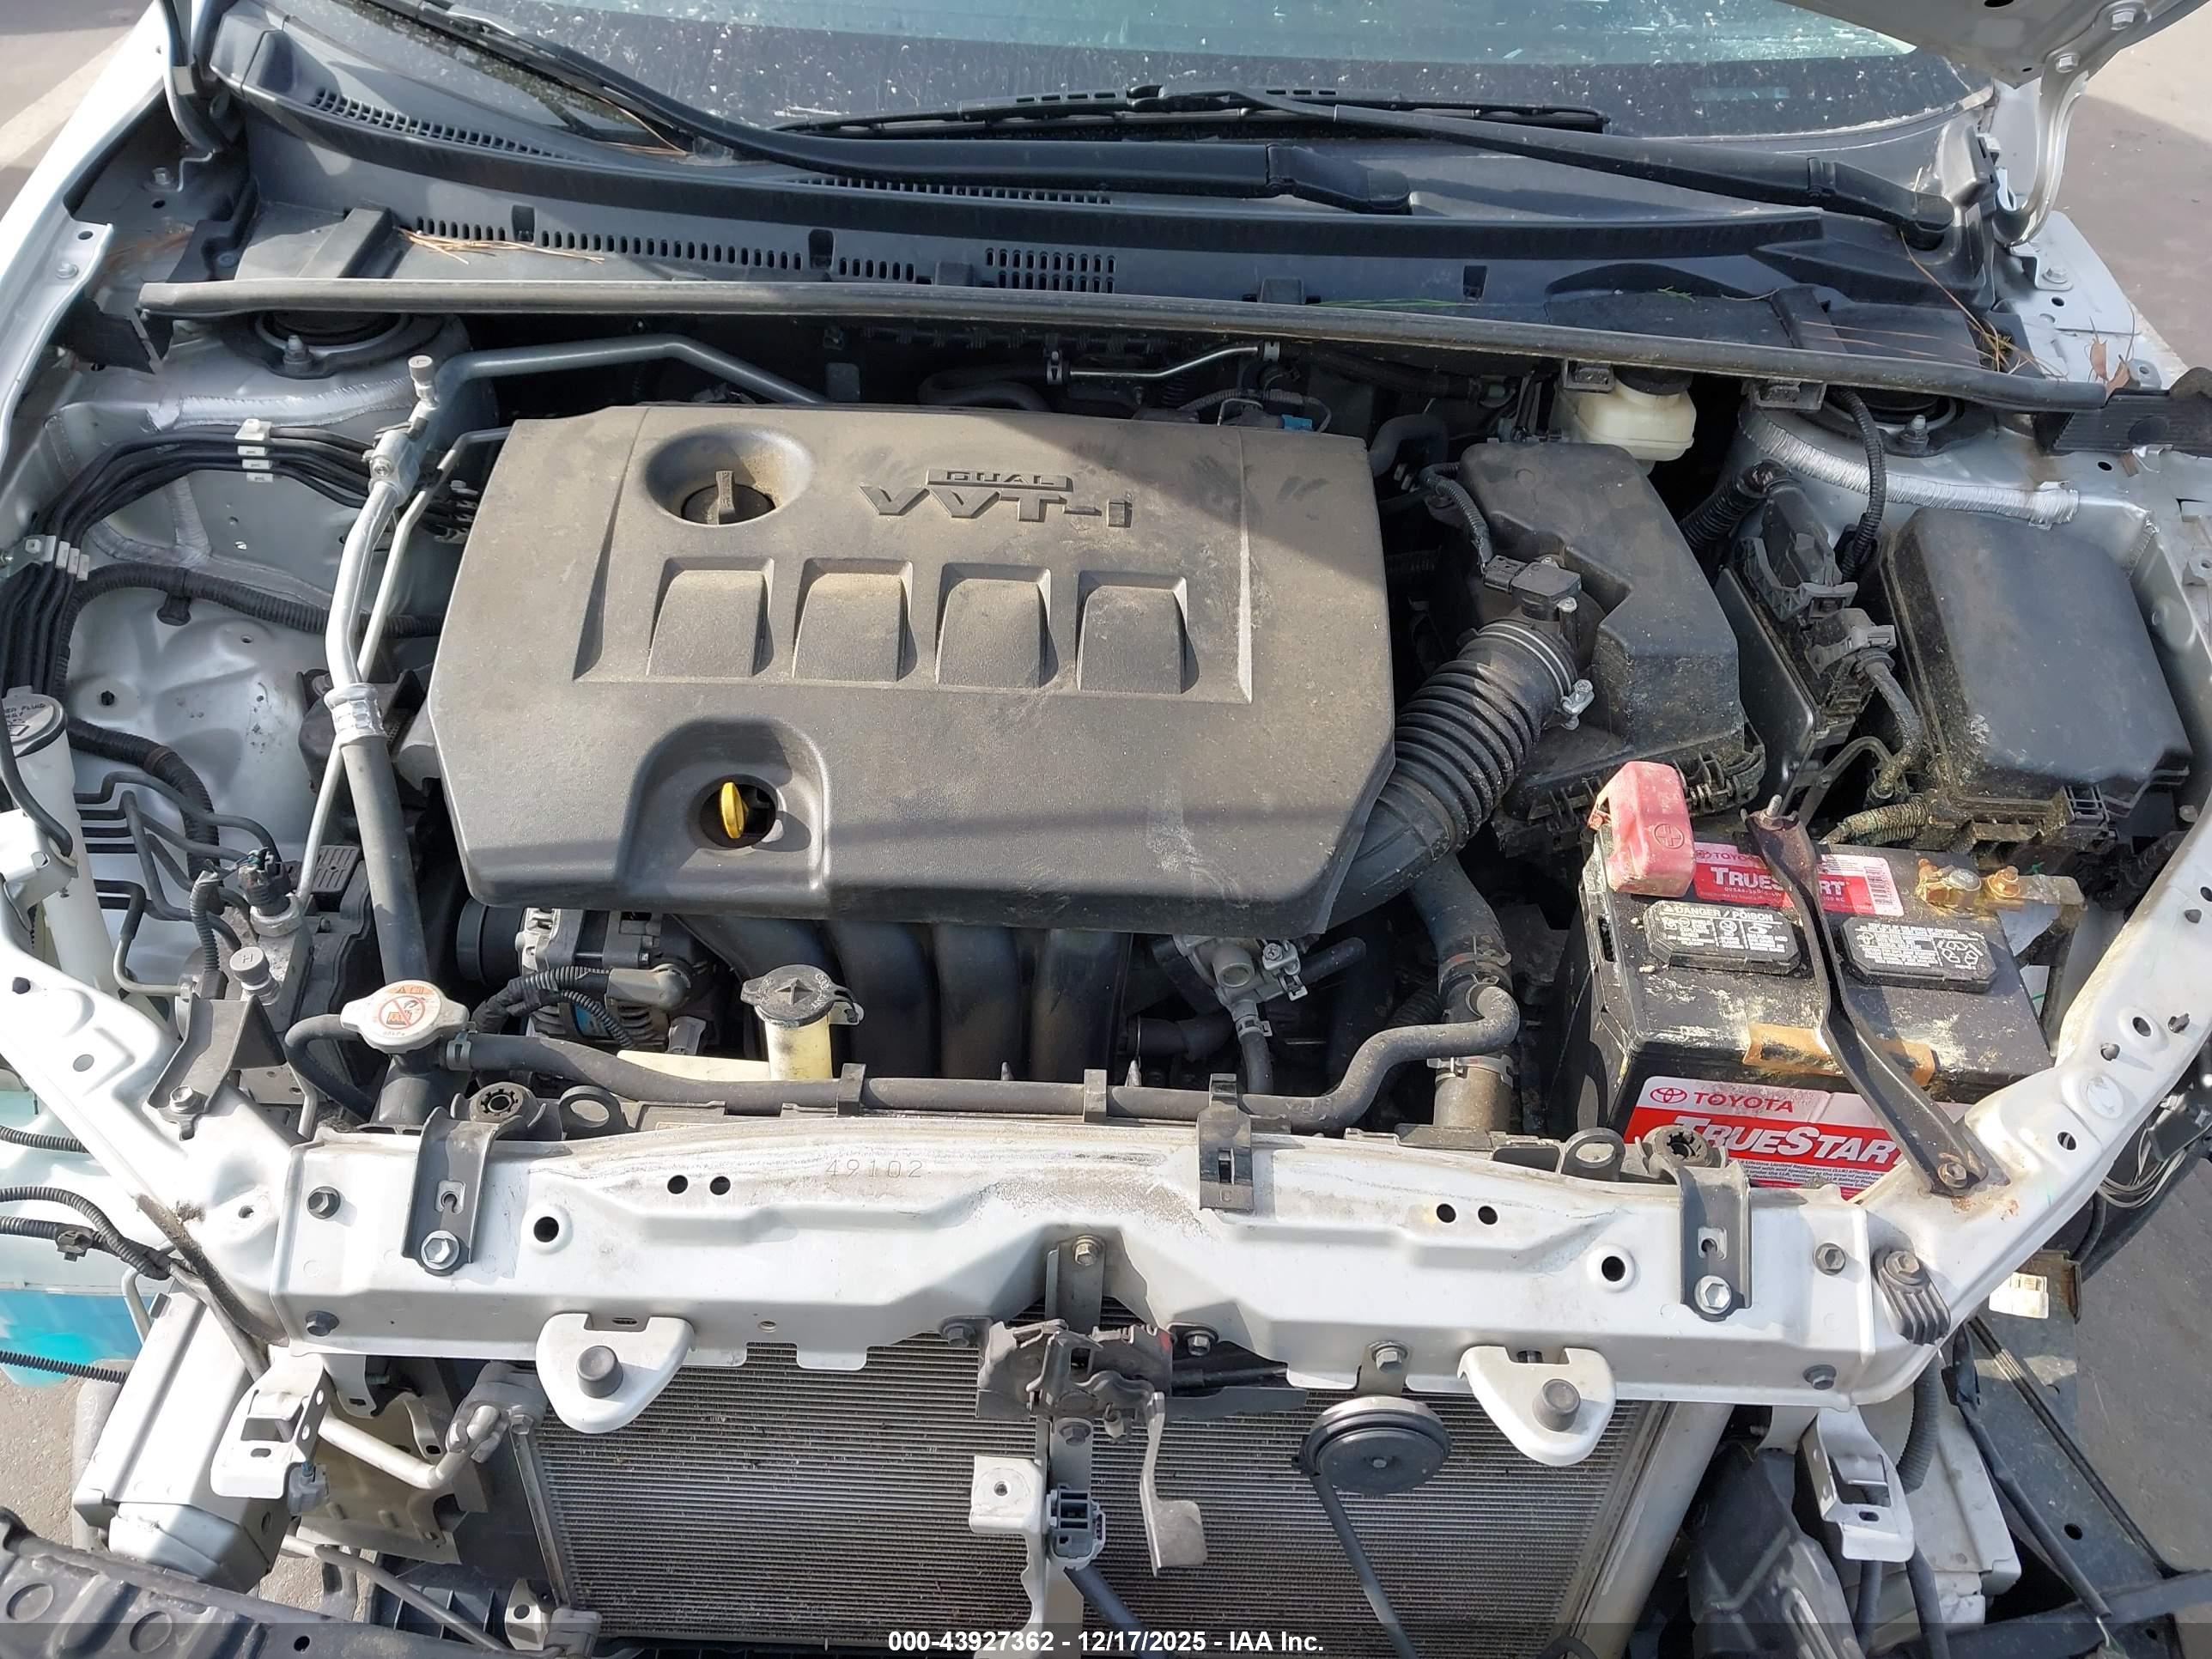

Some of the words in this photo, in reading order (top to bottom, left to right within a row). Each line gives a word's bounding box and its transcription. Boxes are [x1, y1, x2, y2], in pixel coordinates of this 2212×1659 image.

[946, 471, 1056, 486] DUAL
[858, 483, 1133, 529] VVT-i
[1674, 906, 1722, 918] DANGER
[1732, 910, 1774, 922] POISON
[1693, 1091, 1795, 1114] TOYOTA
[1674, 1115, 1905, 1165] TRUESTAR
[825, 1158, 923, 1178] 49102
